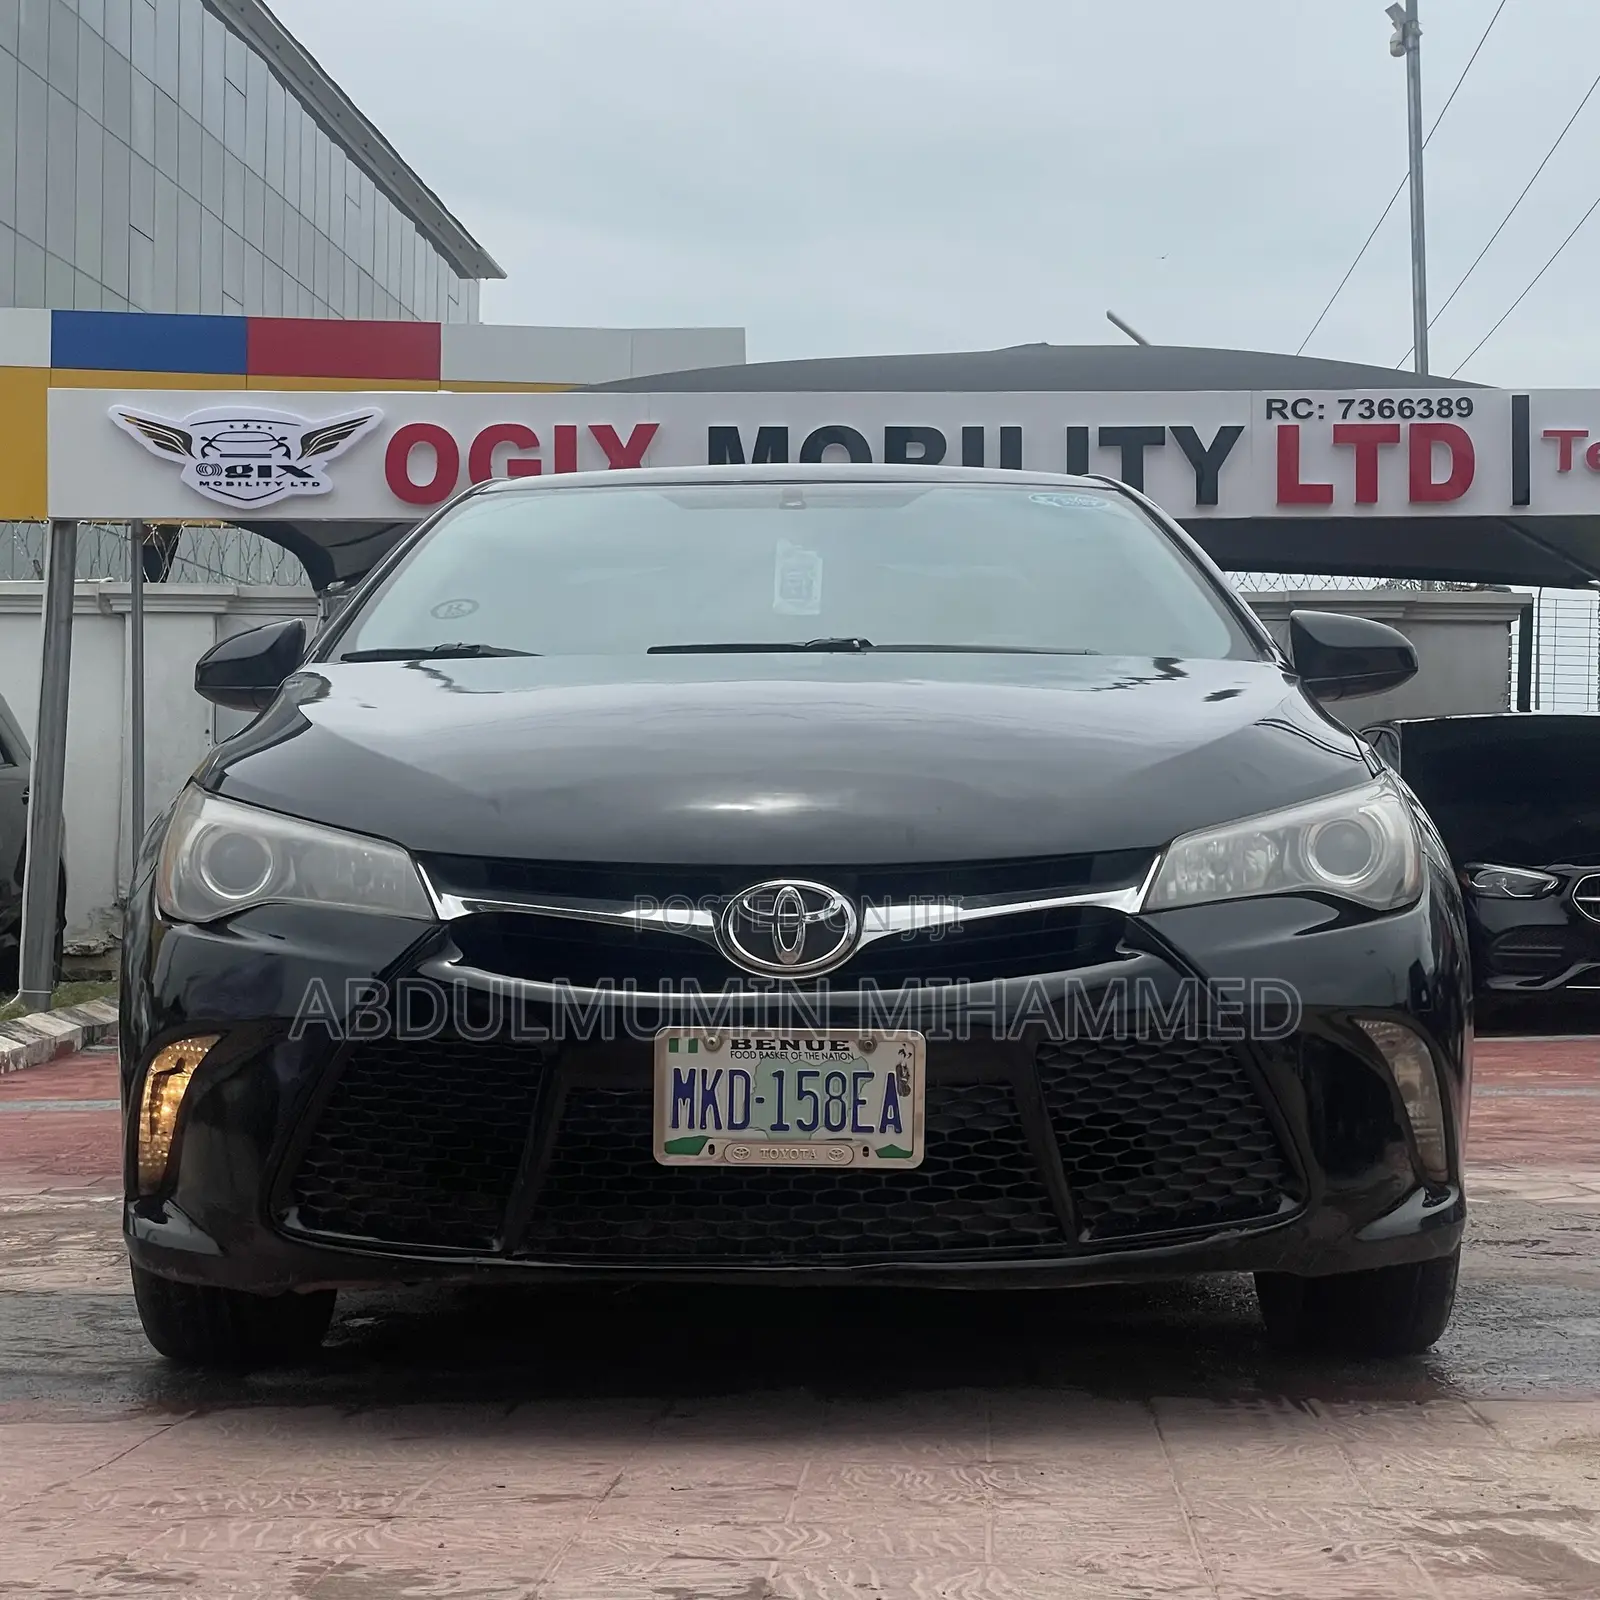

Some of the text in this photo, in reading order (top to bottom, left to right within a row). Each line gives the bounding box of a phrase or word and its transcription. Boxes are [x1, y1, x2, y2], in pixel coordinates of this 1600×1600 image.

[1266, 397, 1474, 420] RC: 7366389
[384, 422, 660, 505] OGIX
[1277, 422, 1475, 504] LTD
[730, 1039, 850, 1051] BENUE
[730, 1050, 854, 1061] FOOD BASKET OF THE NATION
[671, 1068, 902, 1133] MKD-158EA
[760, 1148, 818, 1161] TOYOTA
